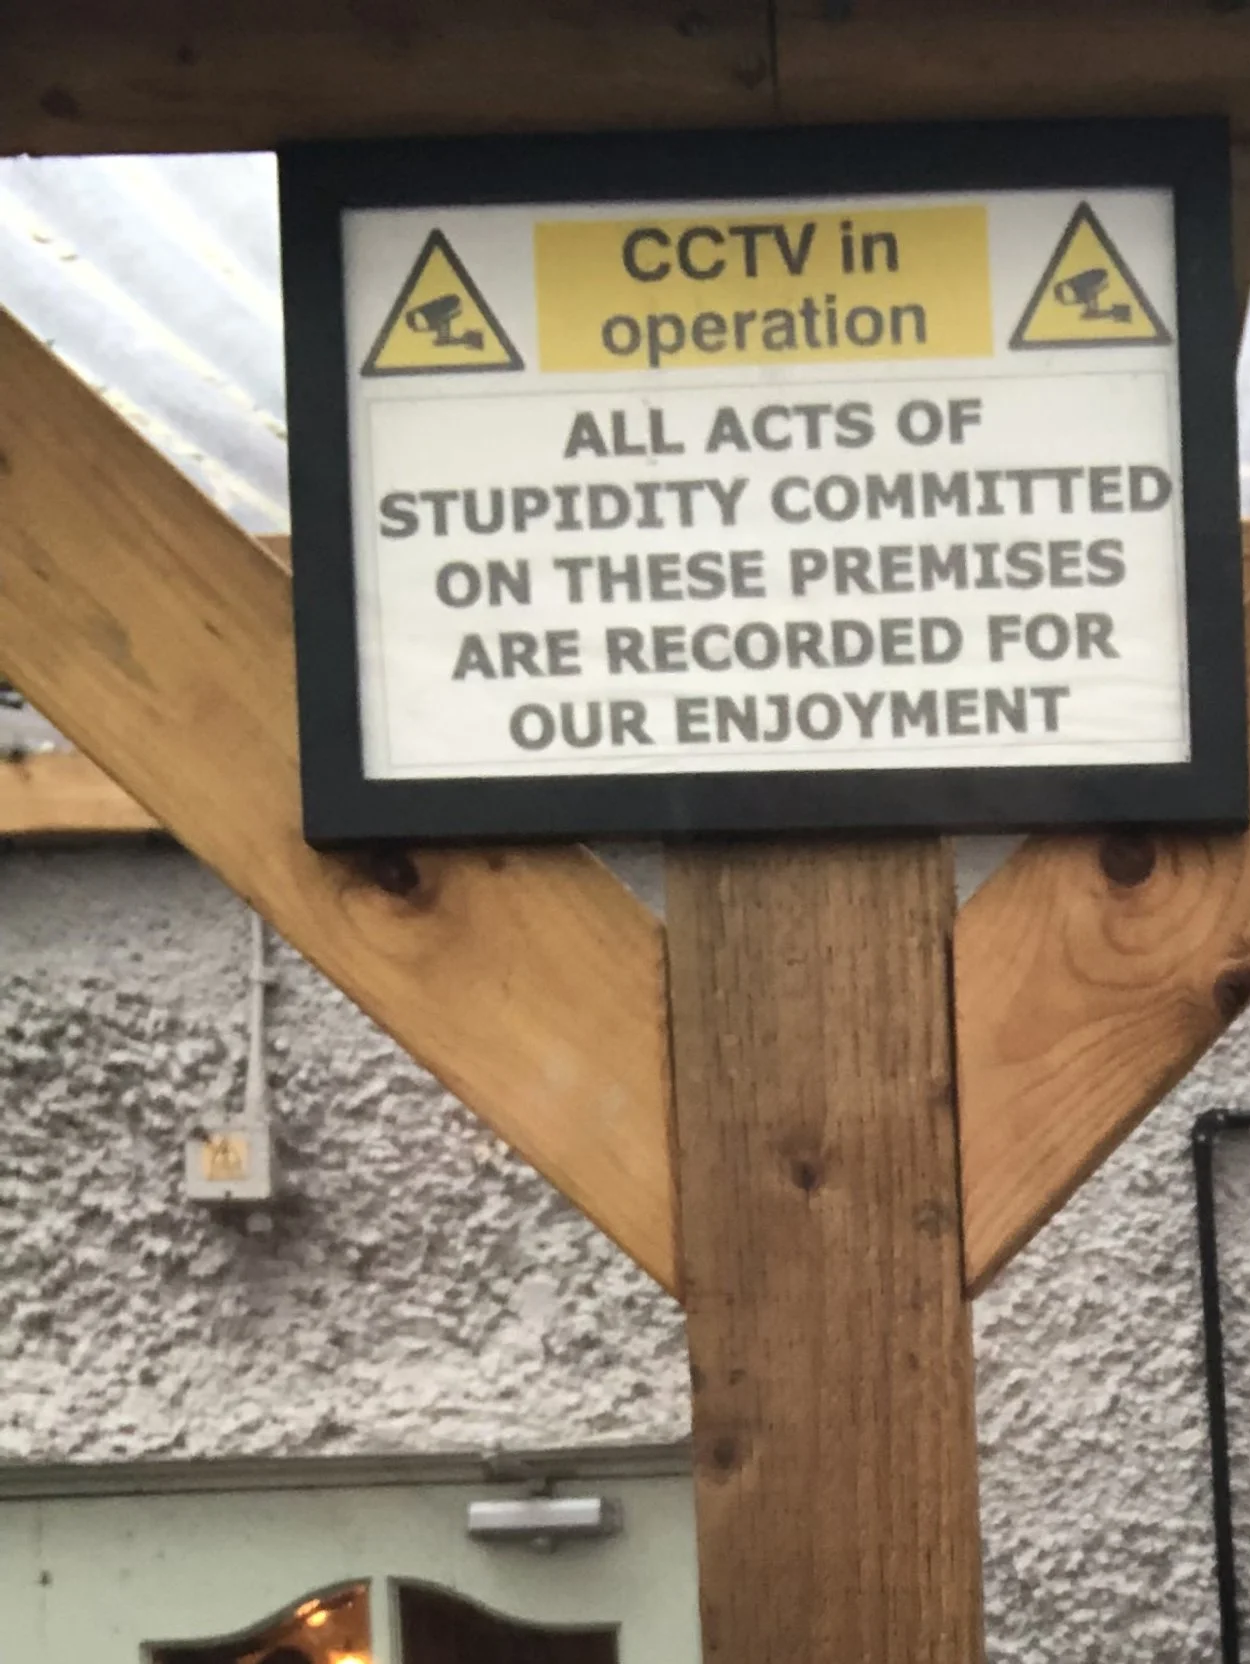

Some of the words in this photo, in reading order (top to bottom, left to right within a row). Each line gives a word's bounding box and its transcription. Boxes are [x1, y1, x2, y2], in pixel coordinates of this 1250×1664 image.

[622, 223, 815, 282] CCTV
[840, 221, 898, 273] in
[601, 296, 926, 367] operation
[564, 408, 684, 458] ALL
[706, 402, 874, 453] ACTS
[897, 398, 981, 446] OF
[379, 478, 748, 540] STUPIDITY
[771, 465, 1172, 524] COMMITTED
[436, 560, 530, 608] ON
[553, 550, 765, 603] THESE
[790, 539, 1125, 597] PREMISES
[452, 630, 581, 680] ARE
[606, 617, 963, 674] RECORDED
[988, 613, 1119, 662] FOR
[510, 700, 653, 750] OUR
[675, 686, 1069, 743] ENJOYMENT
